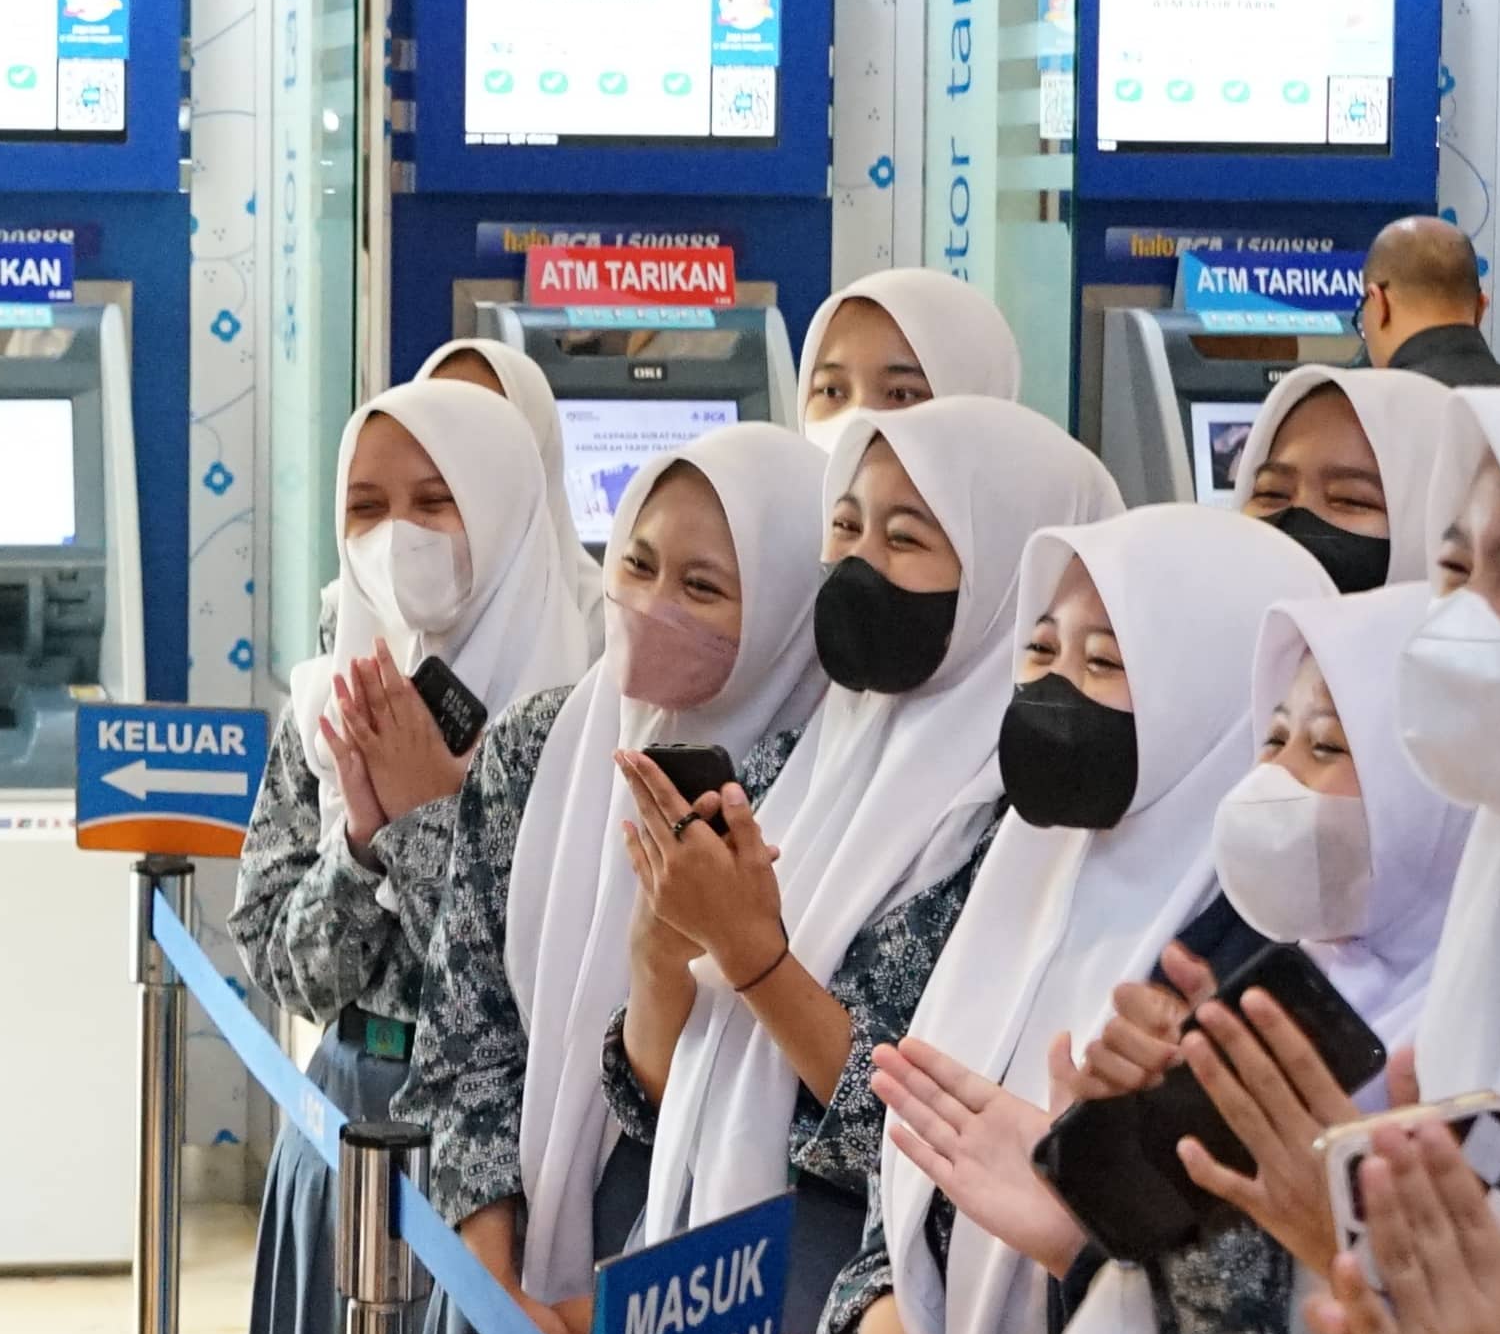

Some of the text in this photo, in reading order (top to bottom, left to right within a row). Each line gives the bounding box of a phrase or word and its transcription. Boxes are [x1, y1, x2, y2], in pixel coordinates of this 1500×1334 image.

[945, 145, 972, 284] tor
[540, 261, 726, 292] ATM TARIKAN
[1197, 267, 1365, 297] ATM TARIKAN
[98, 720, 247, 756] KELUAR
